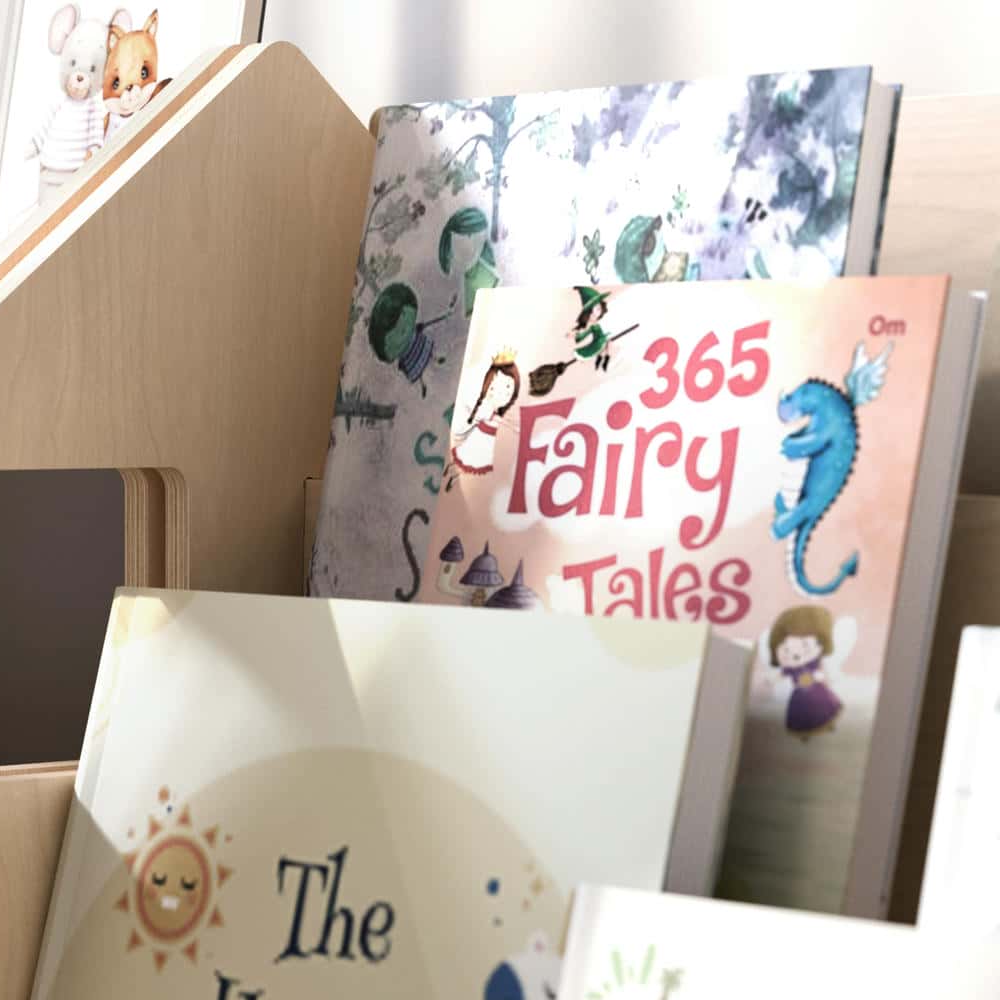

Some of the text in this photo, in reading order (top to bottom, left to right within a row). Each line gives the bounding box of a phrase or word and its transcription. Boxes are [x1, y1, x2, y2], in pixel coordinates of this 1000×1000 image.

[639, 320, 771, 409] 365
[868, 314, 906, 336] Om
[507, 397, 740, 550] Fairy
[562, 546, 751, 624] Tales
[275, 846, 396, 964] The
